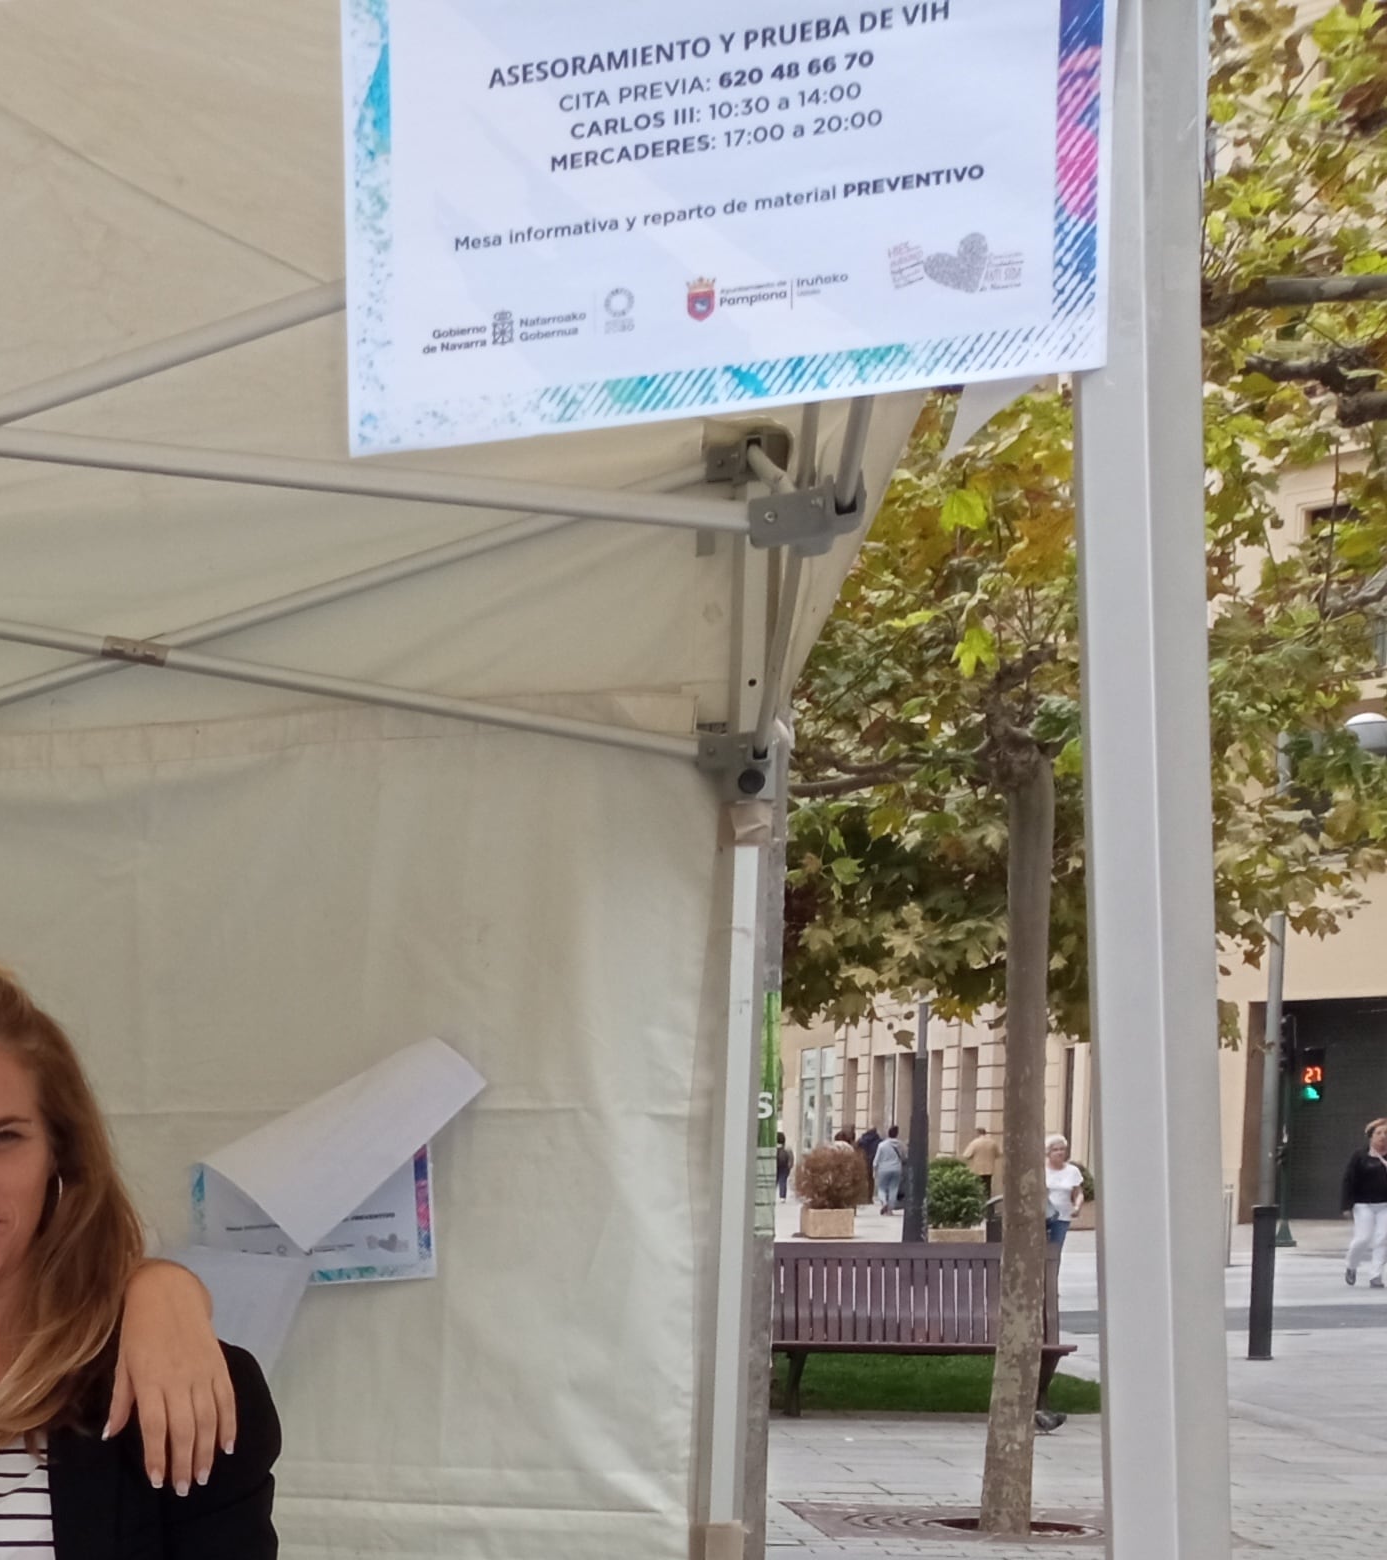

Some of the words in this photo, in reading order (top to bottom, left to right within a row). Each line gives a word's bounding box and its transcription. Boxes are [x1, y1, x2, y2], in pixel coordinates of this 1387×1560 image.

[489, 37, 711, 89] ASESORAMIENTO
[719, 32, 735, 53] Y
[743, 16, 850, 50] PRUEBA
[859, 8, 894, 33] DE
[902, 0, 950, 26] VIH
[559, 90, 610, 112] CITA
[619, 77, 711, 103] PREVIA:
[719, 68, 763, 88] 620
[771, 62, 800, 81] 48
[807, 56, 837, 75] 66
[844, 50, 874, 70] 70
[571, 111, 665, 139] CARLOS
[674, 107, 701, 126] III:
[709, 96, 770, 120] 10:30
[777, 96, 790, 110] a
[798, 82, 862, 107] 14:00
[551, 135, 716, 172] MERCADERES:
[724, 123, 784, 147] 17:00
[792, 123, 805, 138] a
[813, 109, 883, 135] 20:00
[455, 234, 502, 252] Mesa
[509, 218, 619, 244] informativa
[626, 215, 636, 232] y
[643, 203, 716, 227] reparto
[723, 198, 747, 215] de
[754, 184, 837, 211] material
[843, 163, 985, 198] PREVENTIVO
[719, 290, 787, 307] Pamplona
[432, 324, 487, 340] Gobierno
[519, 311, 587, 328] Nafarroako
[519, 326, 578, 342] Gobernua
[423, 343, 437, 355] de
[440, 338, 487, 353] Navarra
